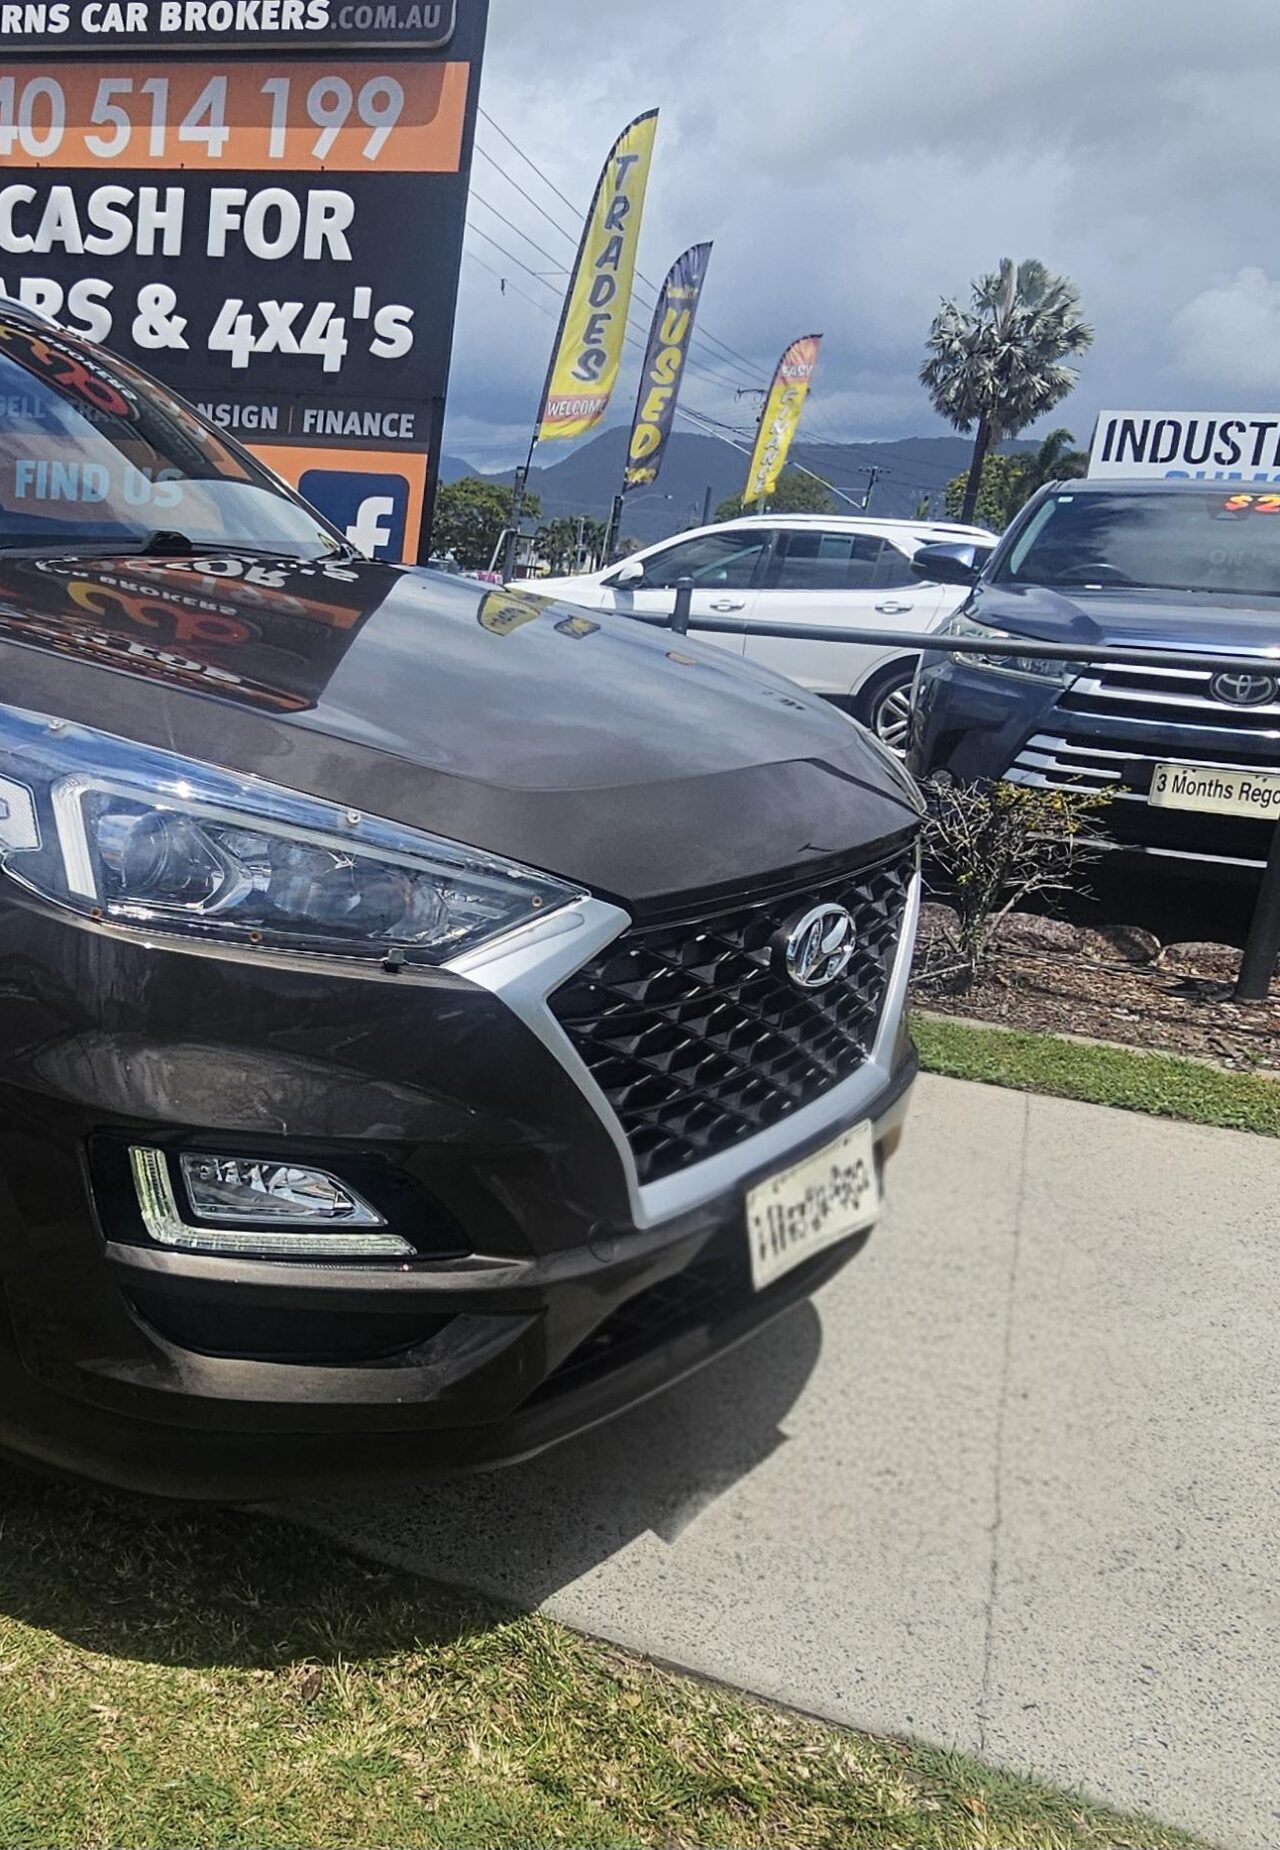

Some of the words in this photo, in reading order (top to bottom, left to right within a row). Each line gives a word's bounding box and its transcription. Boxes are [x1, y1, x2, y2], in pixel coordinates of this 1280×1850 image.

[81, 2, 148, 33] CAR
[160, 0, 330, 32] BROKERS
[83, 76, 230, 158] 514
[261, 75, 406, 161] 199
[207, 187, 356, 262] FOR
[570, 154, 639, 383] TRADES
[131, 283, 190, 351] &
[629, 308, 690, 459] USED
[197, 403, 279, 430] NSIGN
[303, 408, 416, 438] FINANCE
[15, 460, 110, 503] FIND
[123, 467, 185, 508] US
[1157, 774, 1167, 792] 3
[1172, 775, 1234, 799] Months
[1238, 782, 1280, 808] Rego
